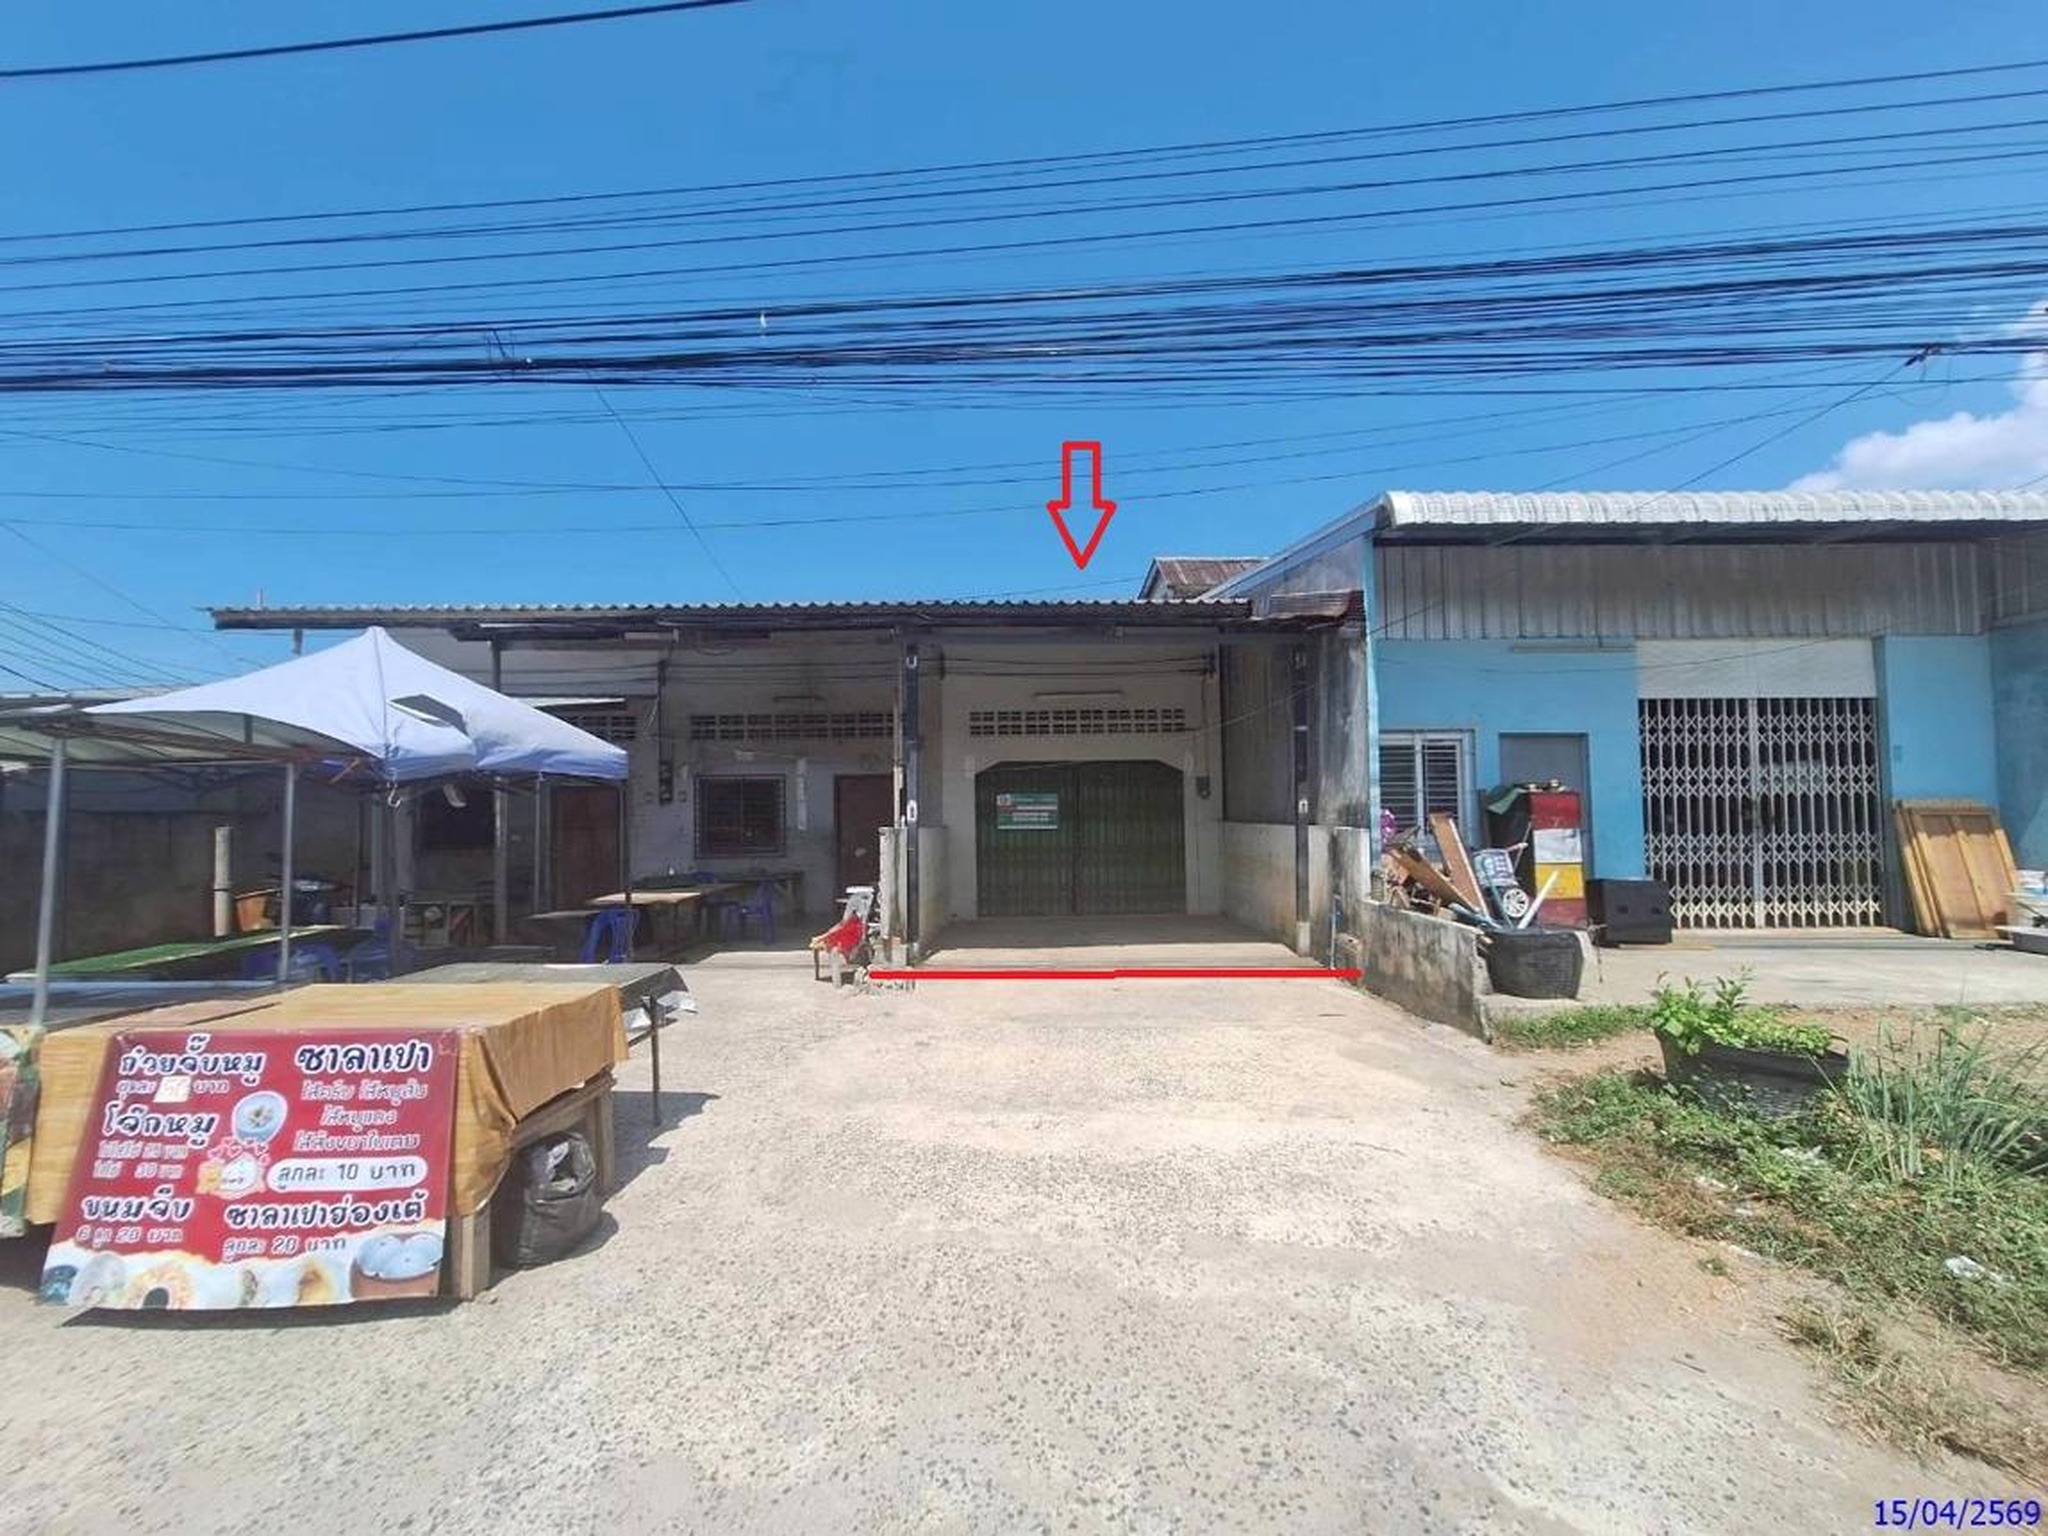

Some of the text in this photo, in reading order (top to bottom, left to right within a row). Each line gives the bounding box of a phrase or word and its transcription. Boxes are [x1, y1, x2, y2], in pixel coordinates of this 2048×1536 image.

[296, 1040, 432, 1074] ซาลาเปา
[103, 1101, 219, 1148] โจ๊กหมู
[277, 1162, 415, 1190] ลูกละ 10 บาท
[82, 1184, 195, 1221] ขนมจีบ
[224, 1191, 428, 1229] ซาลาเปาฮ่องเต้
[271, 1235, 298, 1254] 20
[305, 1236, 346, 1252] บาท
